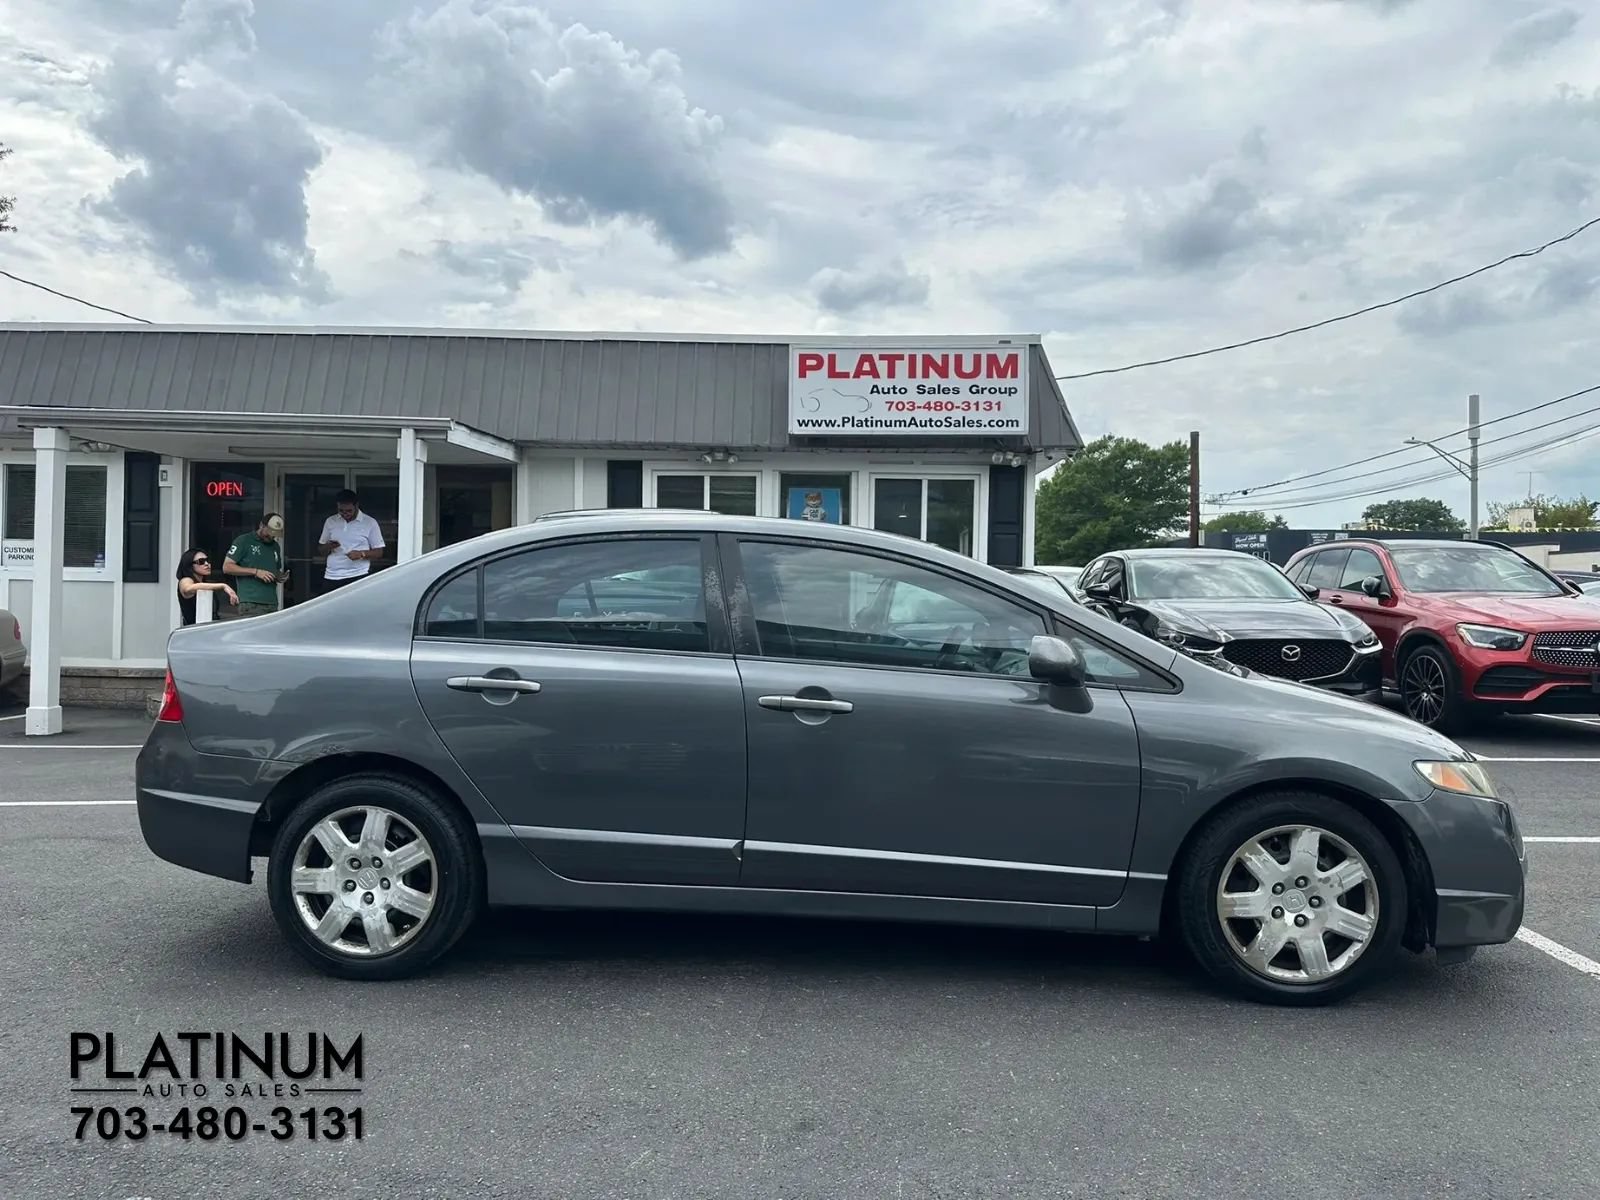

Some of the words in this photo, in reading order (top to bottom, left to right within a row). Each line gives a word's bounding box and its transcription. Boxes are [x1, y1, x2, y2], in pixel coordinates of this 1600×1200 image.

[798, 353, 1019, 379] PLATINUM
[870, 384, 908, 396] Auto
[916, 384, 960, 396] Sales
[969, 384, 1018, 397] Group
[885, 400, 1002, 412] 703-480-3131
[797, 416, 1020, 428] www.PlatinumAutoSales.com
[207, 481, 243, 496] OPEN
[228, 545, 237, 555] 3
